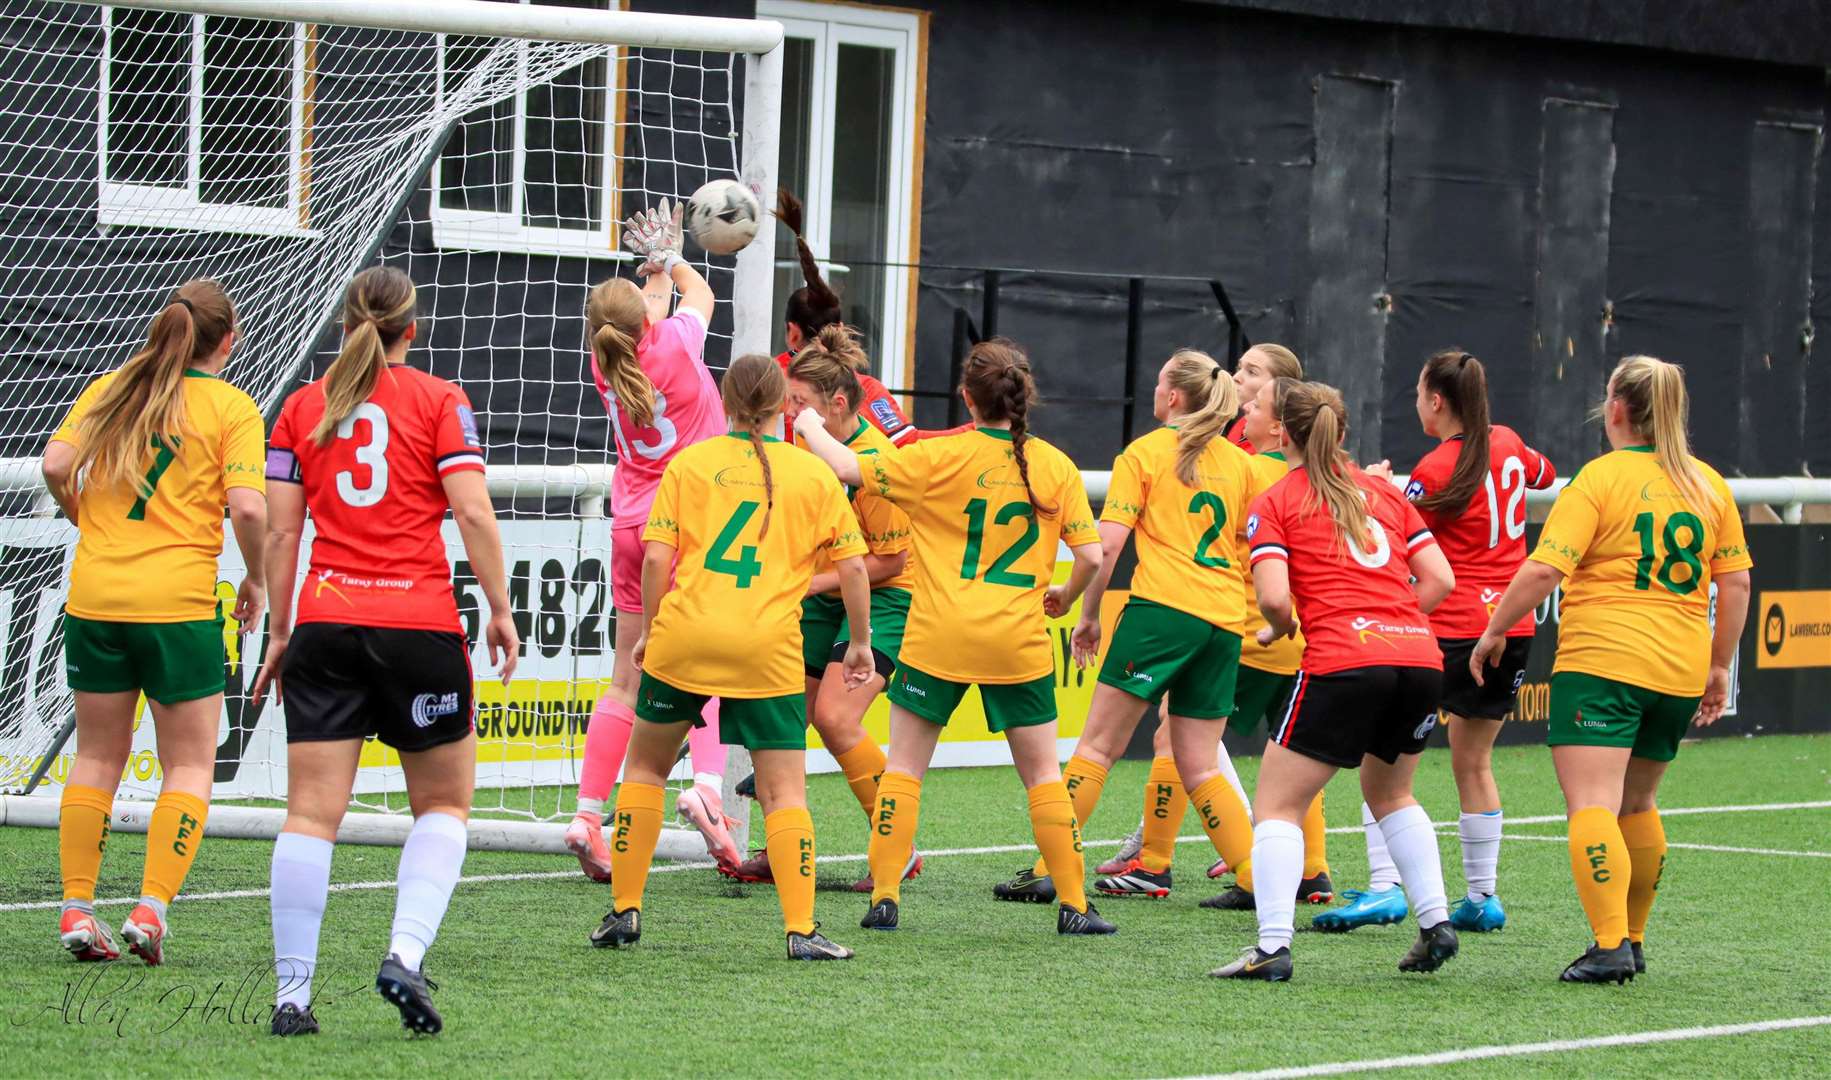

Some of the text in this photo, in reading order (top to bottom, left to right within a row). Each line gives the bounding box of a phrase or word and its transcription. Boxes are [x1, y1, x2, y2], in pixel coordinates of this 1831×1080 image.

[604, 388, 677, 460] 13
[336, 402, 390, 508] 3
[1485, 455, 1526, 549] 12
[704, 500, 762, 588] 4
[960, 497, 1039, 589] 12
[1188, 491, 1231, 569] 2
[1632, 511, 1704, 595] 18
[375, 579, 414, 590] Group
[452, 558, 616, 659] 5482
[426, 702, 458, 715] TYRES
[441, 692, 458, 704] M2
[1511, 683, 1550, 721] rom
[476, 700, 593, 738] GROUNDW
[878, 797, 896, 836] HFC
[1154, 783, 1173, 819] HFC
[1201, 799, 1221, 830] FC
[173, 812, 197, 857] HFC
[615, 812, 632, 853] HFC
[800, 837, 812, 877] HFC
[1586, 843, 1611, 884] HFC
